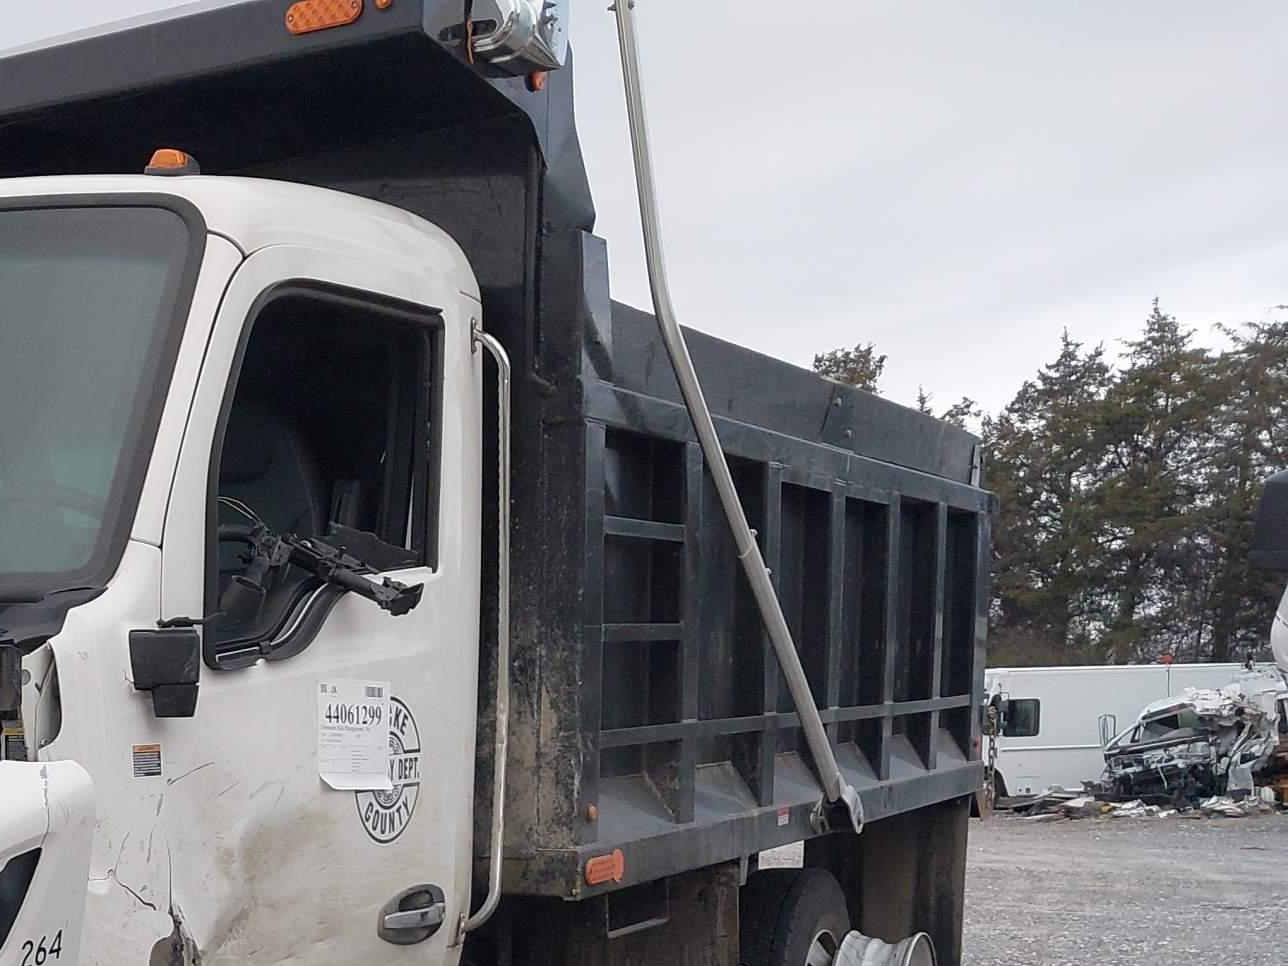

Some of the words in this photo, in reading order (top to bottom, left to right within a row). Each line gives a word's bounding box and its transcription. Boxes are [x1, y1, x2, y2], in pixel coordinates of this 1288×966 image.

[324, 703, 383, 726] 44061299
[398, 757, 420, 780] DEPT.
[364, 797, 410, 835] COUNTY
